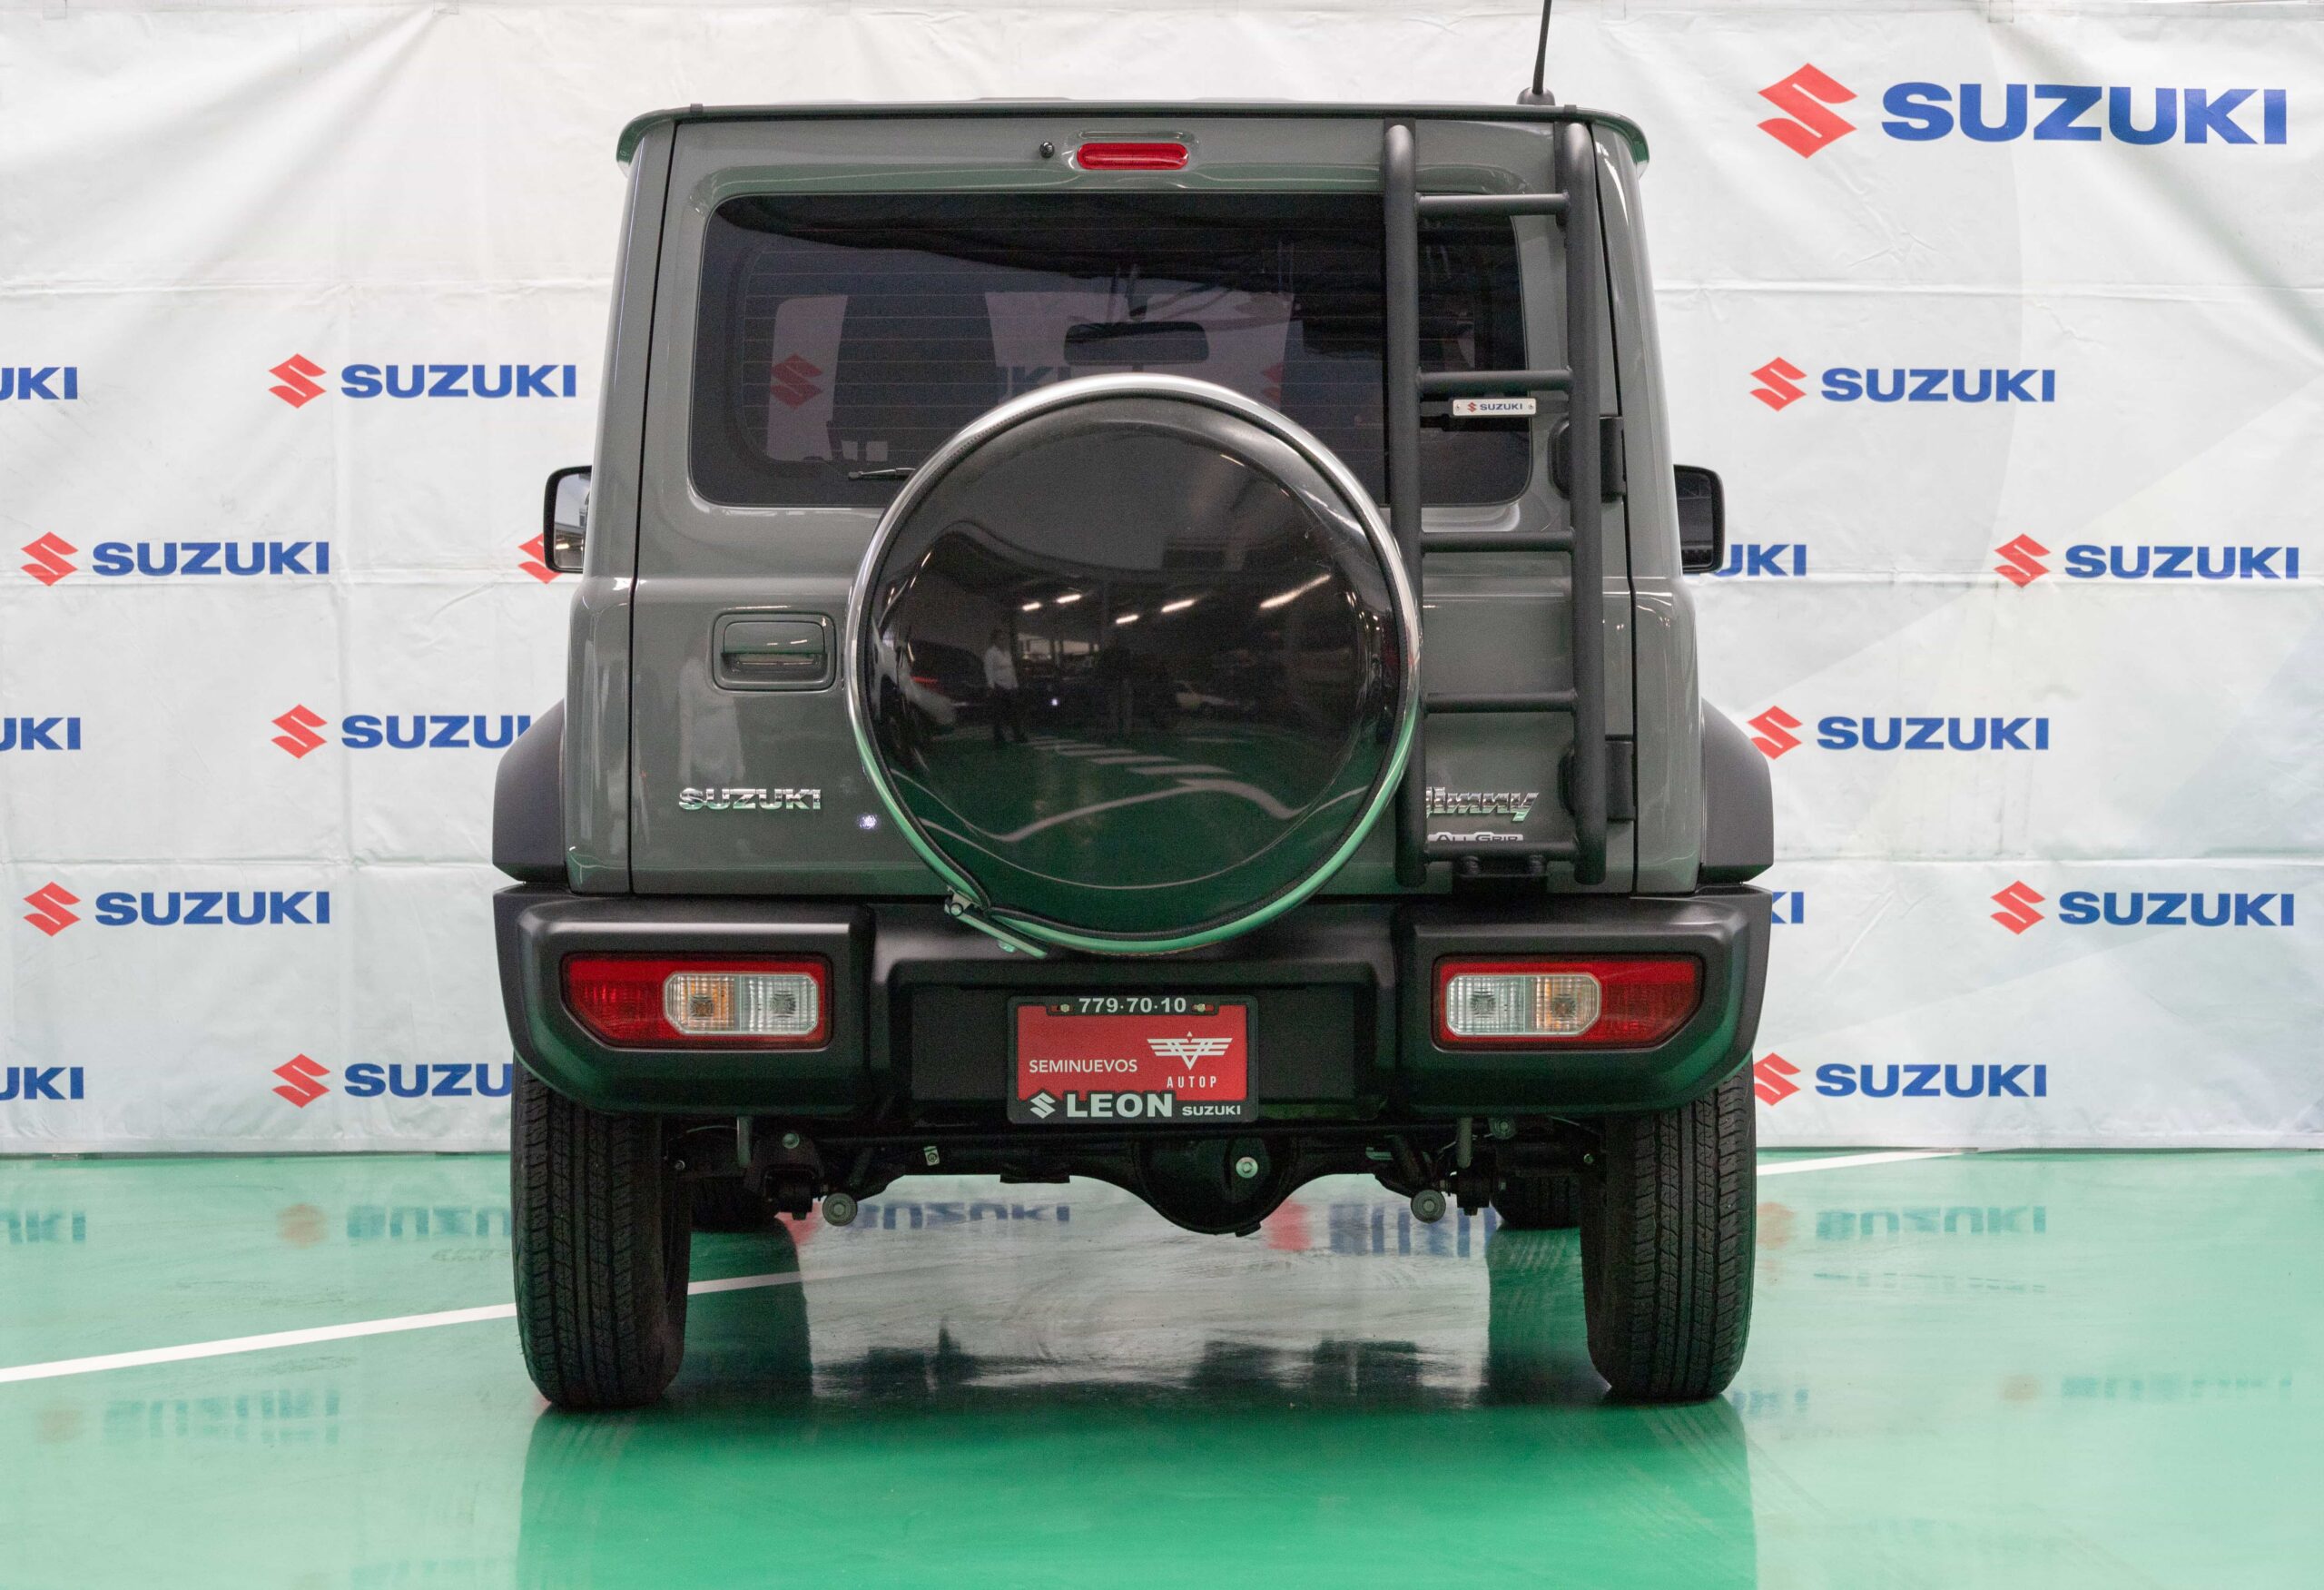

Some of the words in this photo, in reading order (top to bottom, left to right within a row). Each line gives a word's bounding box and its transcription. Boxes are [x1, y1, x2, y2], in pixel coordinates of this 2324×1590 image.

[1881, 82, 2287, 145] SUZUKI
[340, 364, 576, 398] SUZUKI
[1821, 368, 2056, 402] SUZUKI
[93, 542, 330, 576] SUZUKI
[2064, 545, 2299, 579] SUZUKI
[1817, 716, 2050, 751] SUZUKI
[679, 787, 821, 810] SUZUKI
[94, 891, 330, 926] SUZUKI
[2058, 891, 2295, 927] SUZUKI
[1029, 1059, 1137, 1073] SEMINUEVOS
[1167, 1075, 1217, 1089] AUTOP
[1815, 1063, 2048, 1099] SUZUKI
[1067, 1092, 1173, 1118] LEON
[1182, 1105, 1241, 1116] SUZUKI
